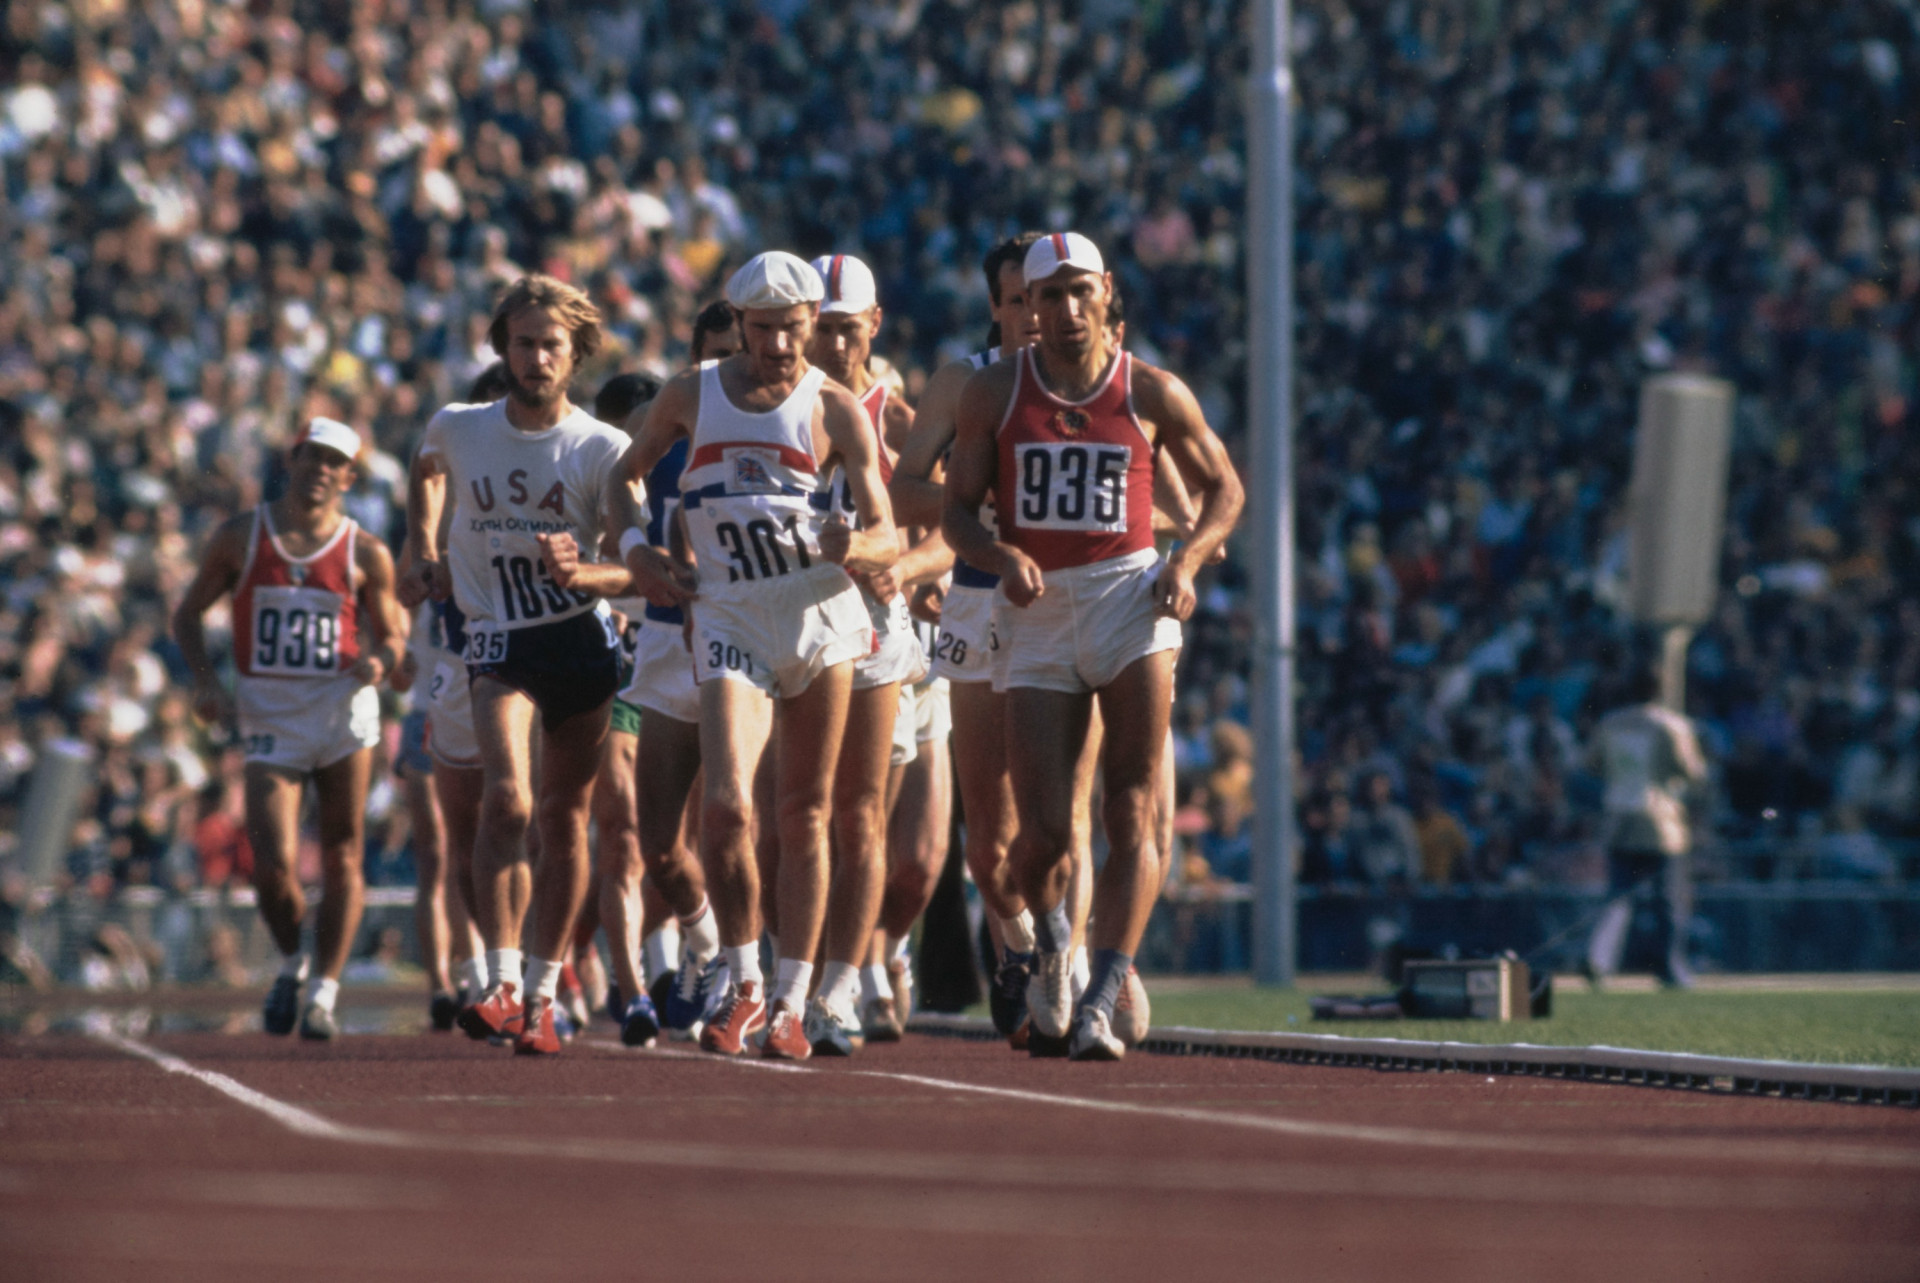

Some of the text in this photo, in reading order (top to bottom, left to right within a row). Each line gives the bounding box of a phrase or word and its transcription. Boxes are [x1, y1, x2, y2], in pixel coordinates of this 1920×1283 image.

[472, 469, 564, 516] USA
[1022, 446, 1127, 524] 935
[505, 517, 577, 532] OLYMPIA
[717, 514, 811, 583] 301
[492, 554, 592, 620] 103
[259, 608, 335, 670] 939
[708, 640, 753, 675] 301
